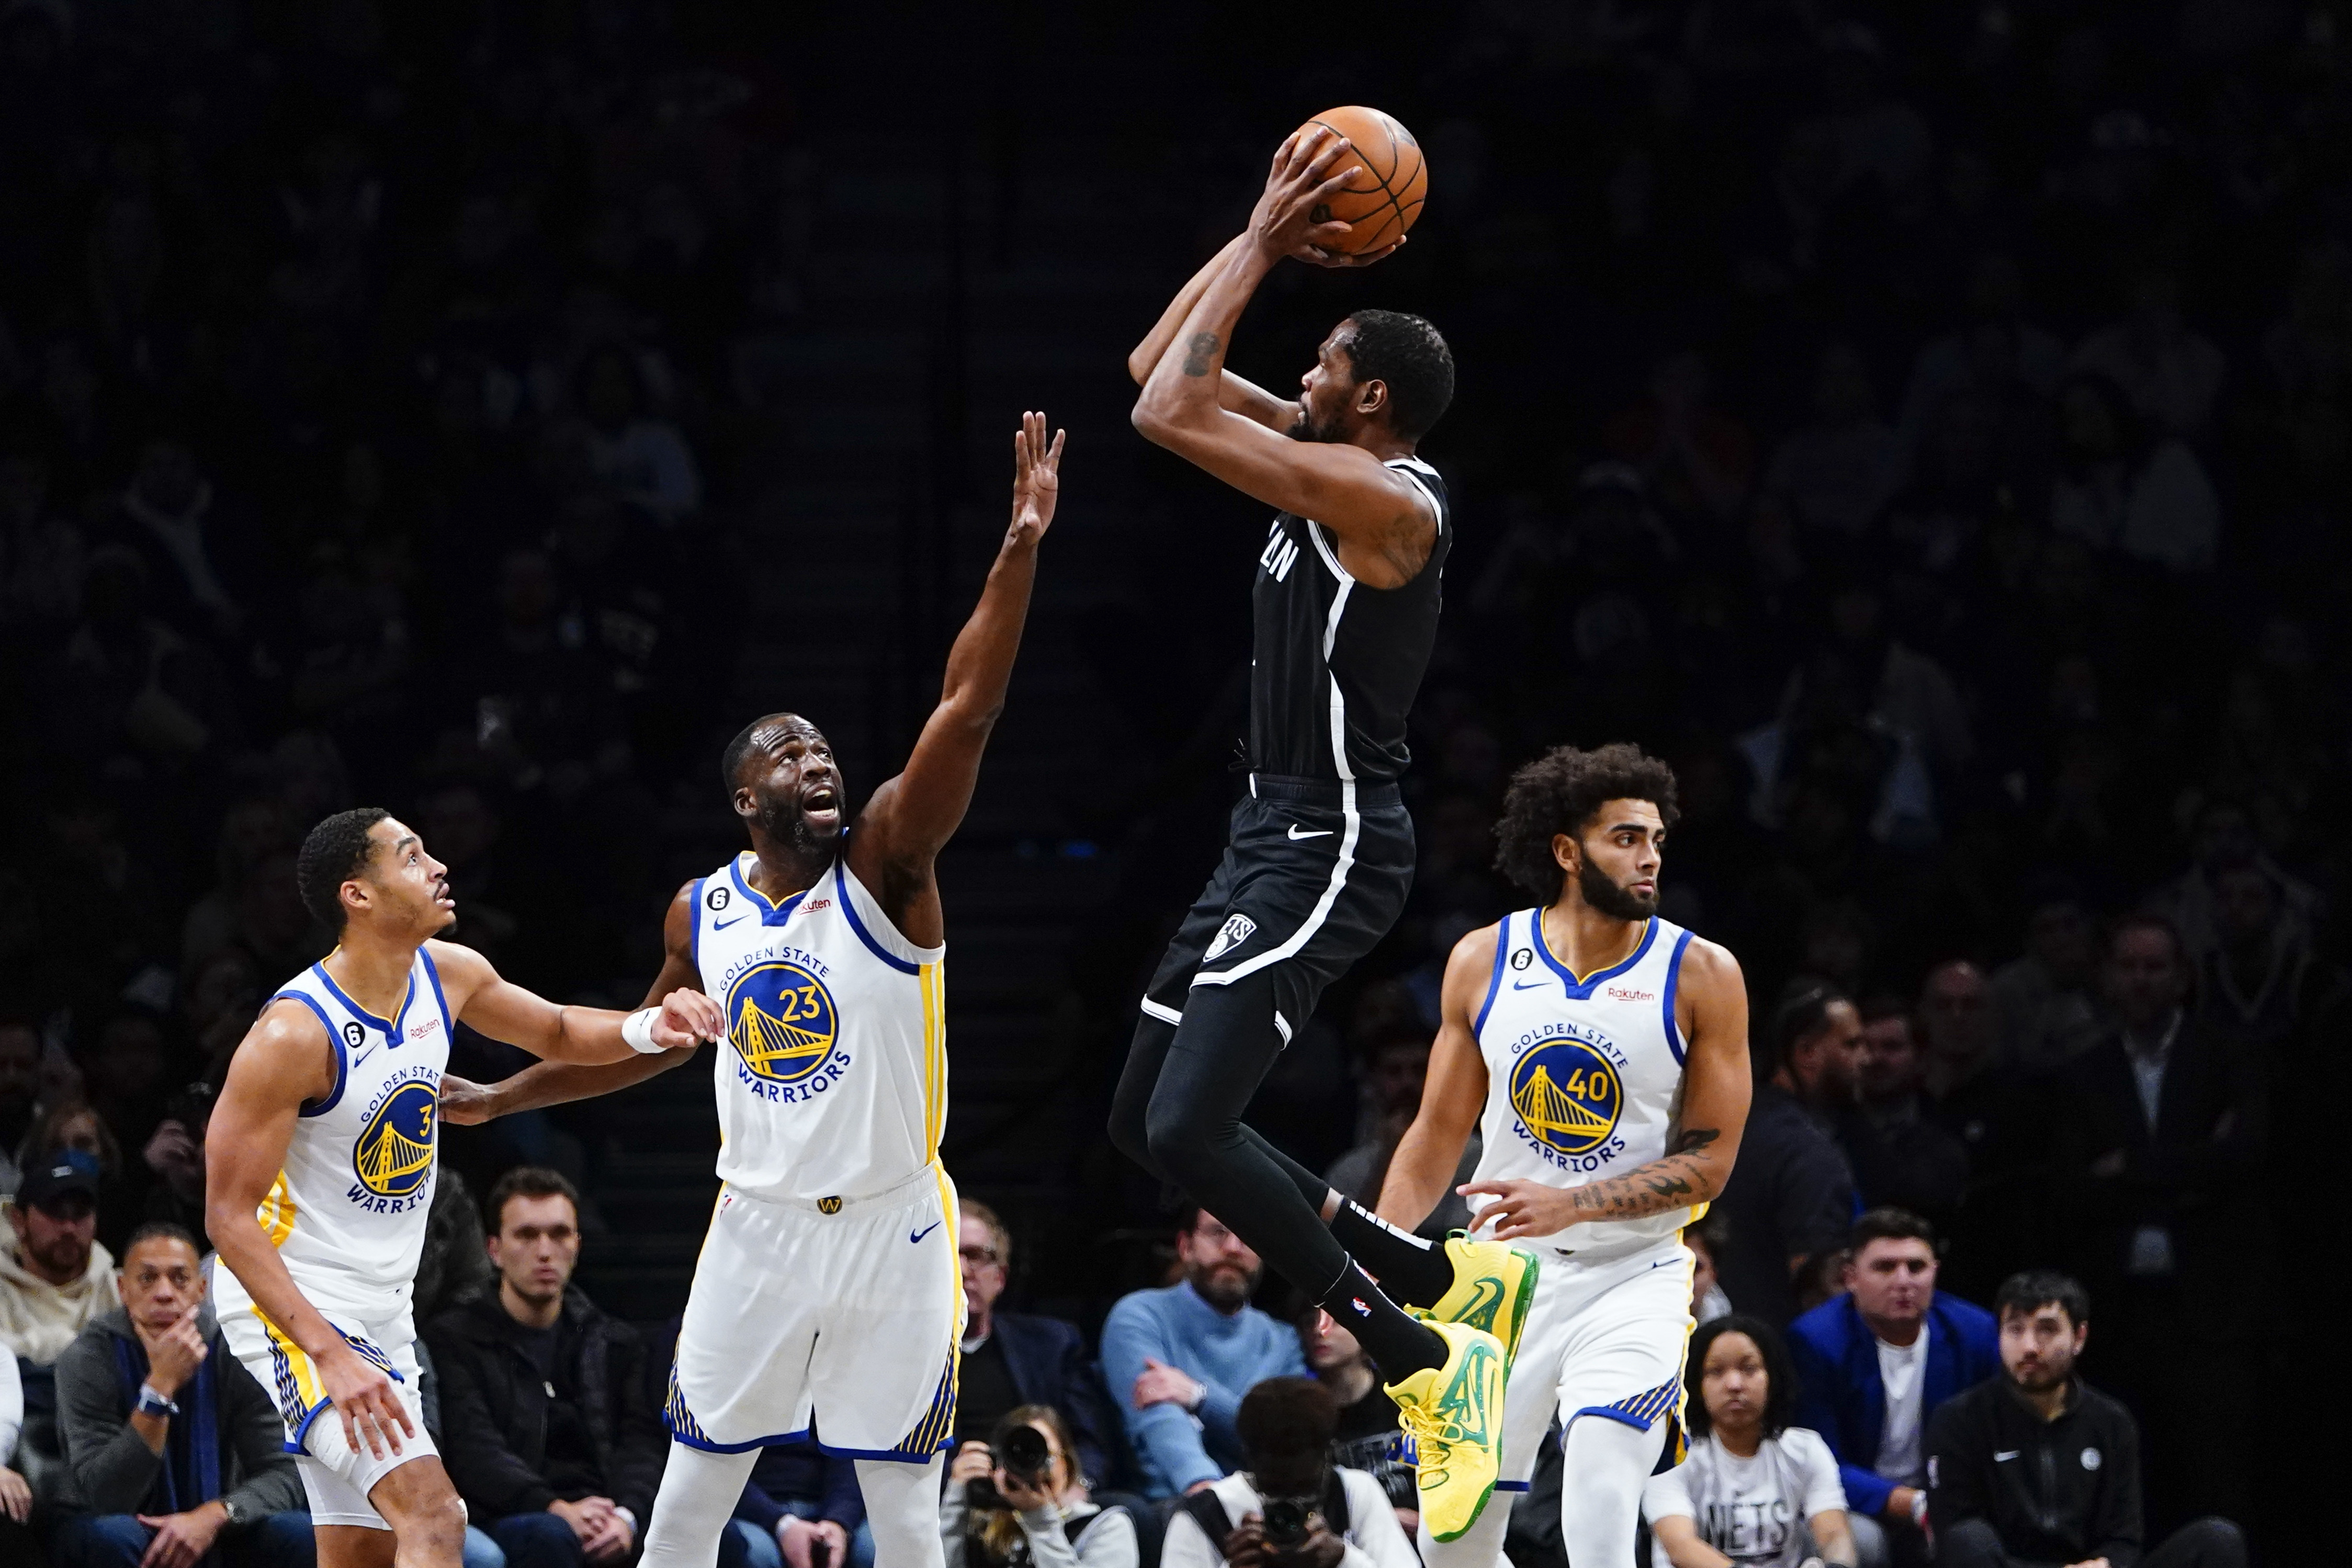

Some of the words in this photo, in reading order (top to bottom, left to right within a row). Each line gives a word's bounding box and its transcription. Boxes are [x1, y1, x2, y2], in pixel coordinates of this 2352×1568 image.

[712, 890, 726, 908] 6
[797, 899, 831, 915] kuten
[1214, 916, 1251, 940] ETS
[720, 947, 774, 991] GOLDEN
[783, 947, 829, 978] STATE
[1513, 950, 1530, 970] 6
[779, 985, 820, 1022] 23
[1608, 987, 1654, 1002] Rakuten
[346, 1025, 361, 1047] 6
[410, 1019, 440, 1039] Rakuten
[1511, 1023, 1577, 1054] GOLDEN
[1586, 1029, 1629, 1069] STATE
[738, 1051, 851, 1103] WARRIORS
[1566, 1068, 1609, 1101] 40
[361, 1068, 408, 1122] GOLDEN
[412, 1066, 439, 1084] STAT
[419, 1104, 433, 1137] 3
[1512, 1119, 1625, 1173] WARRIORS
[819, 1198, 841, 1212] W
[1705, 1499, 1789, 1550] NETS
